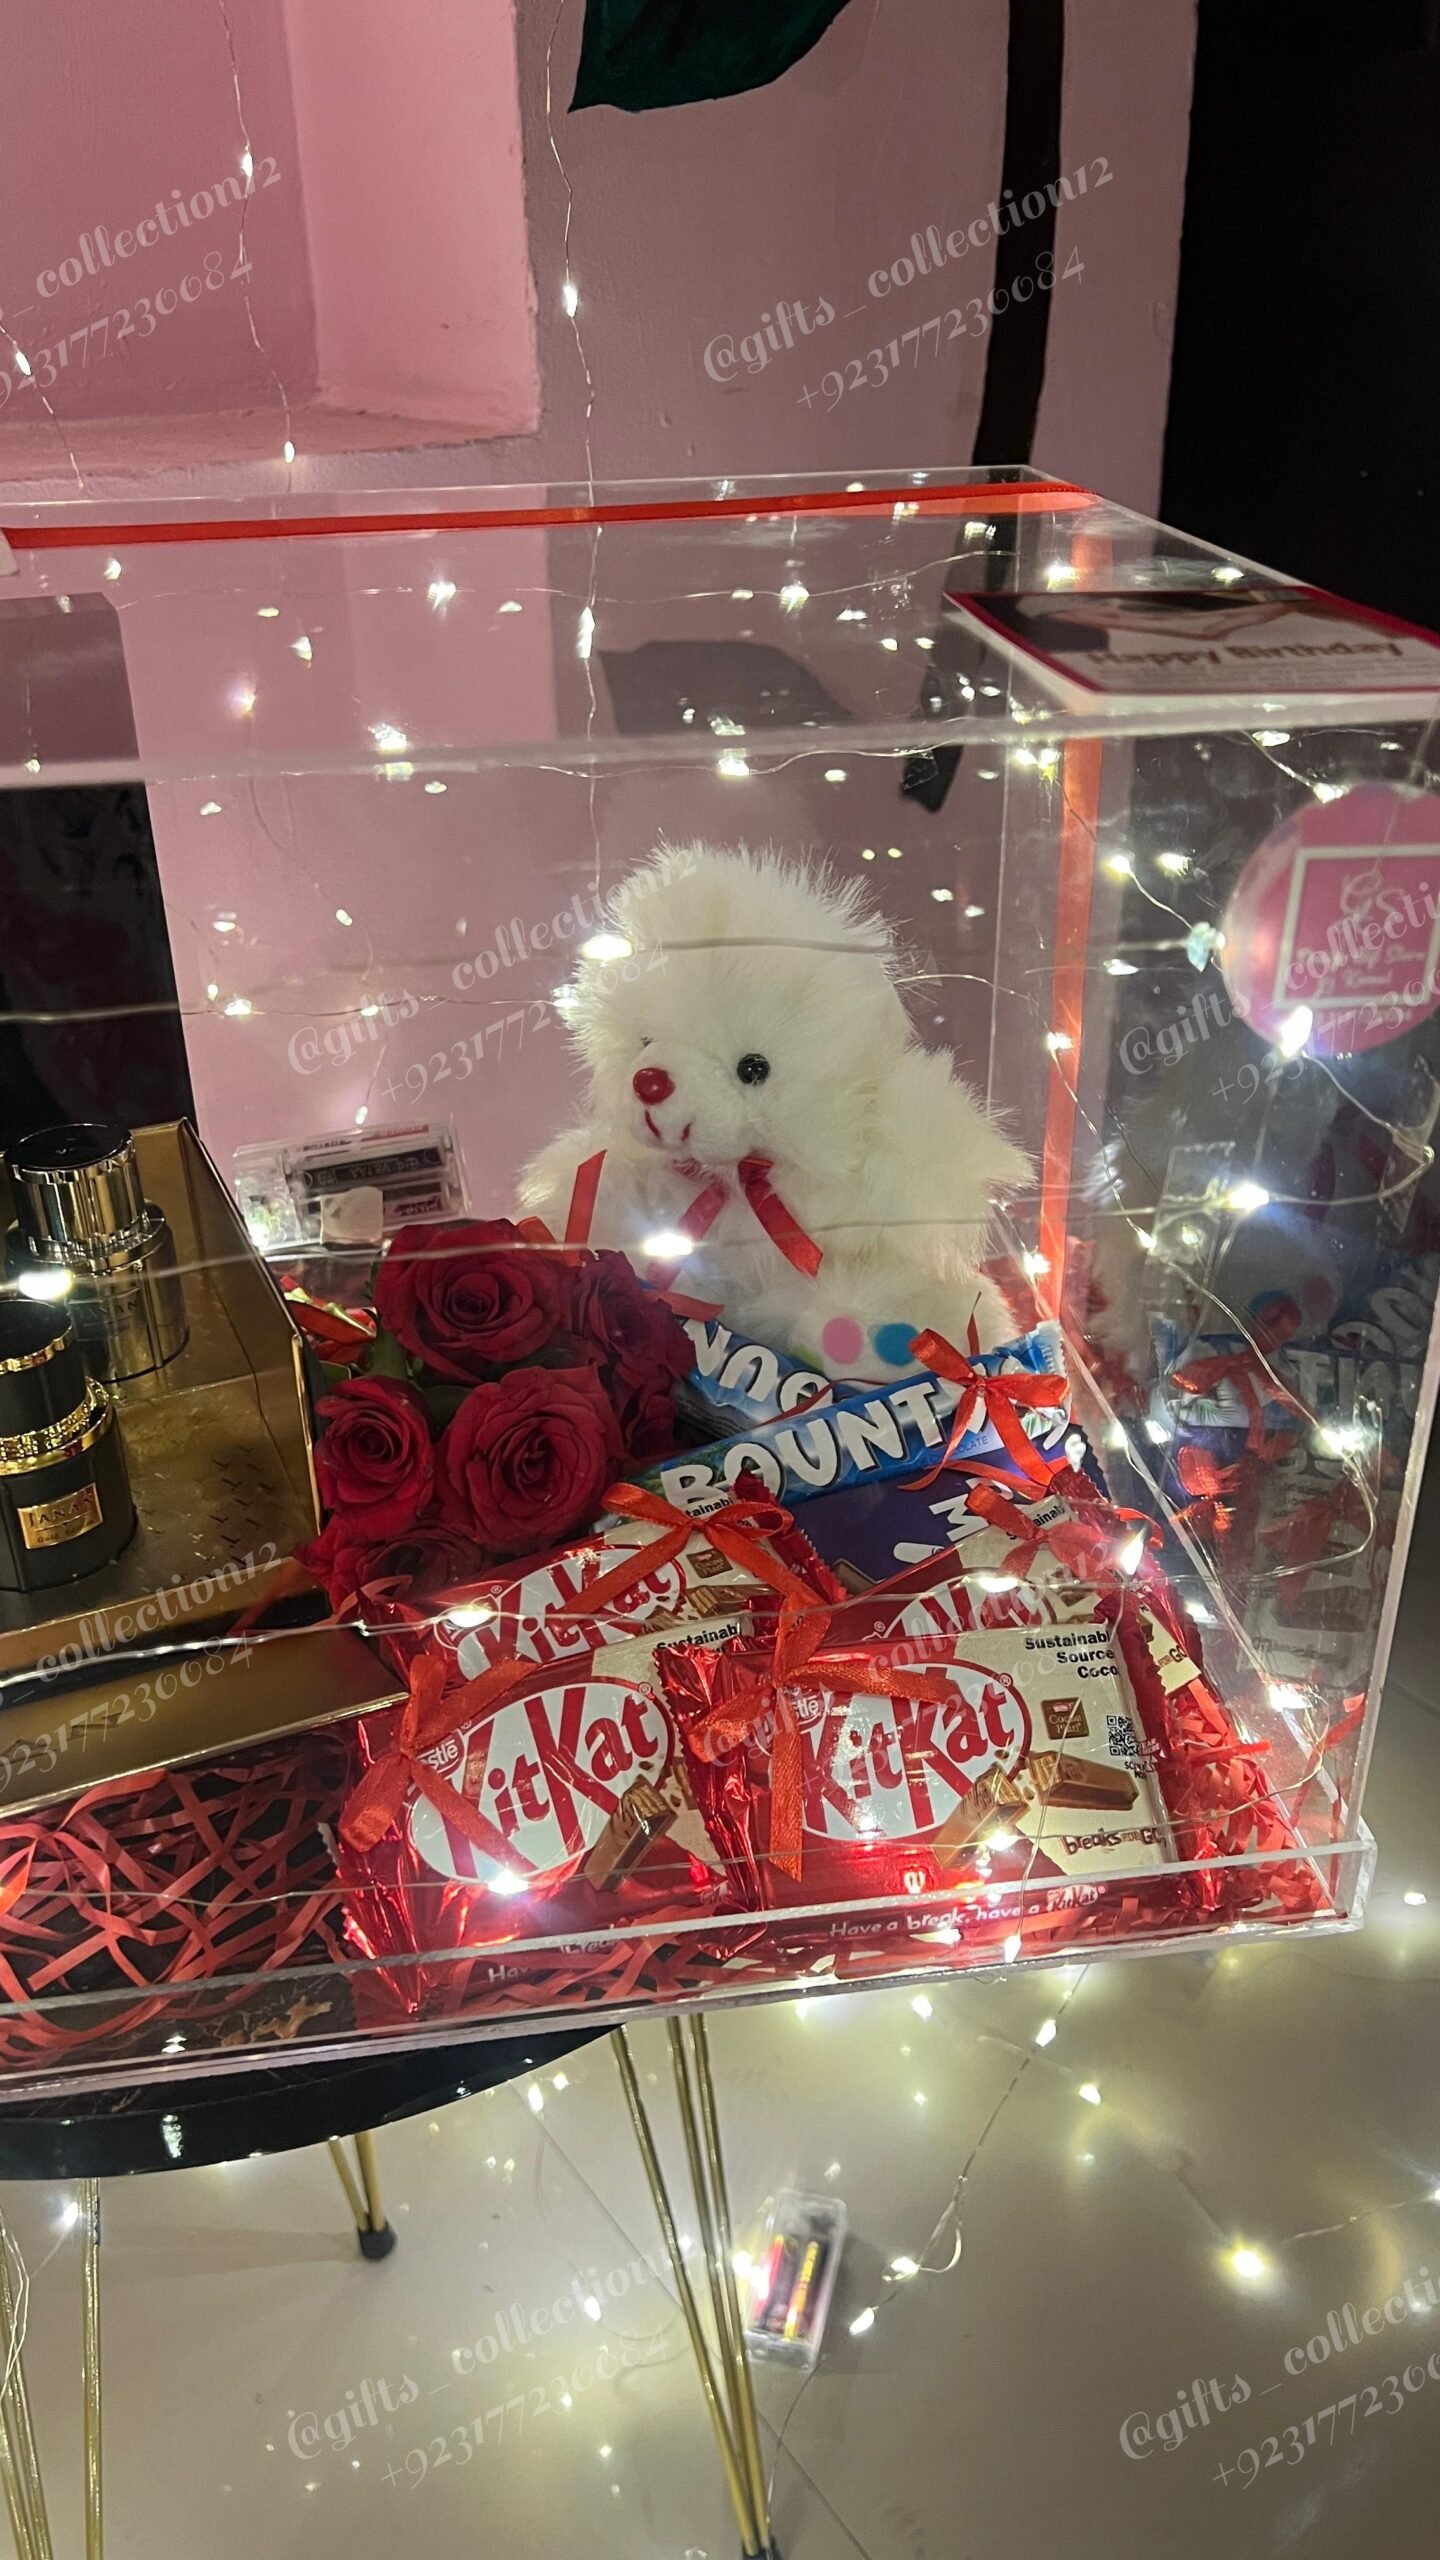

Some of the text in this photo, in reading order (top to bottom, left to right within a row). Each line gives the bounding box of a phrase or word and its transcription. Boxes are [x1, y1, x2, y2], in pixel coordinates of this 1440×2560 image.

[1226, 642, 1402, 659] Birthday
[440, 1686, 659, 1877] KitKat
[801, 1666, 1016, 1834] KitKat
[831, 1922, 881, 1938] Have
[887, 1921, 898, 1931] a
[976, 1904, 1023, 1921] have
[1028, 1905, 1040, 1914] a
